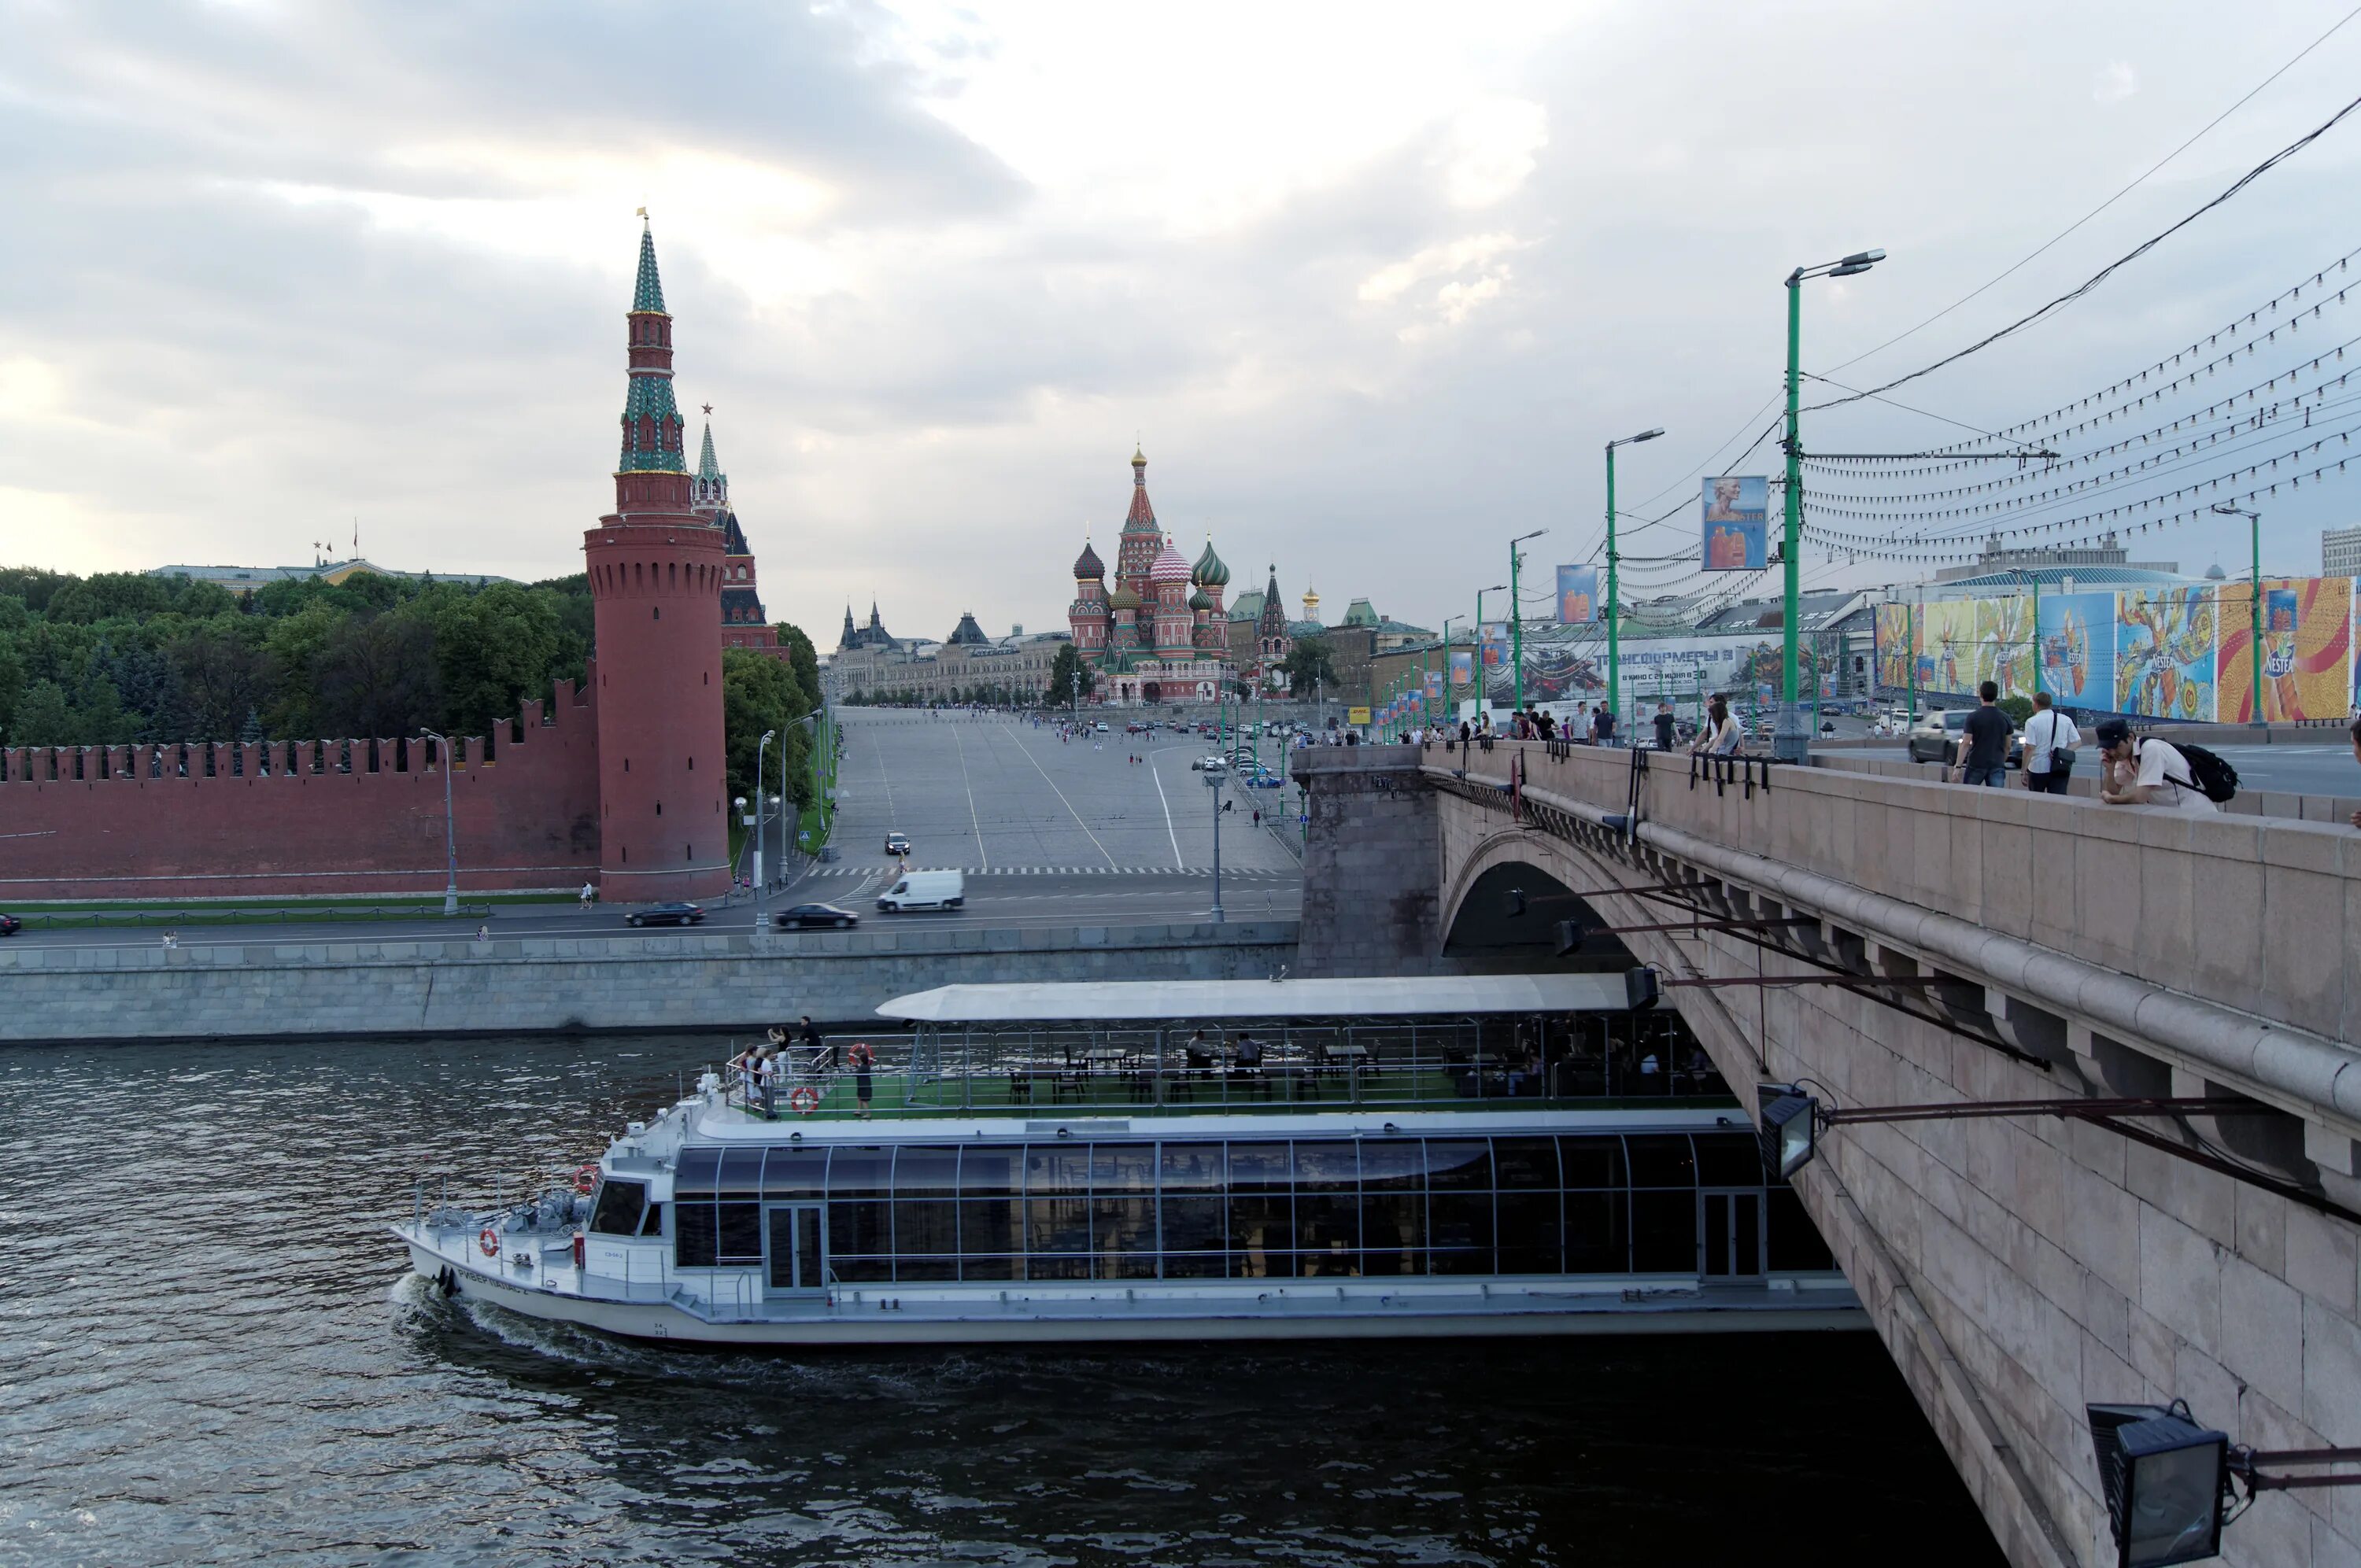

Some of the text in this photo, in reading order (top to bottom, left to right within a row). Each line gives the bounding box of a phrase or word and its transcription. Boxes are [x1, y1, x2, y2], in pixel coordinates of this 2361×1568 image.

[2153, 654, 2174, 670] NESTEA
[2266, 655, 2294, 673] NESTEA
[458, 1268, 488, 1284] РИВЕР
